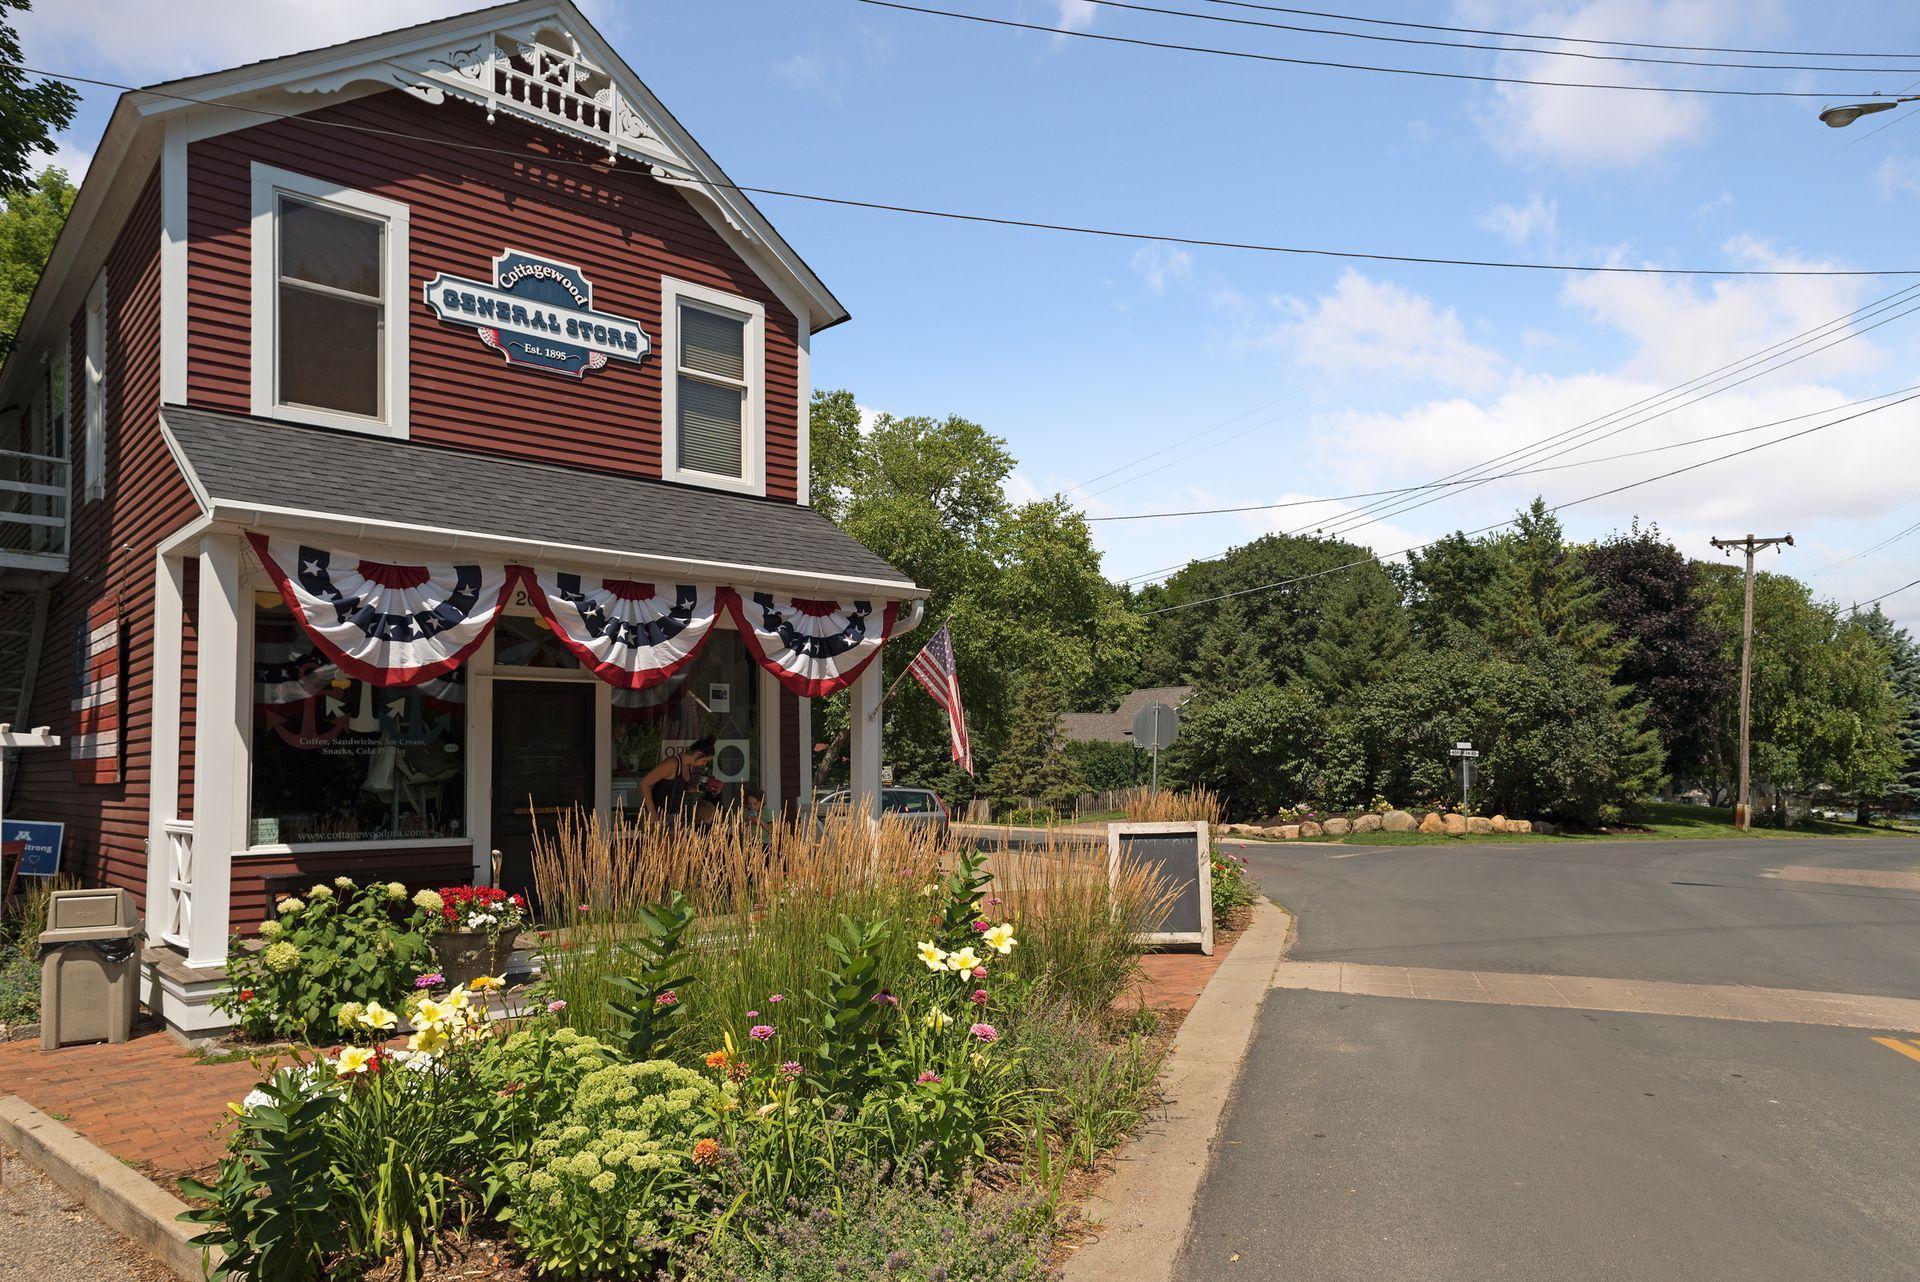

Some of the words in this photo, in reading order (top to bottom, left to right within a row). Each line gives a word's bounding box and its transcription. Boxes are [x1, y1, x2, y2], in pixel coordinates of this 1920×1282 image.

[499, 263, 588, 306] Cottagewood
[442, 289, 561, 334] GENERAL
[566, 318, 638, 351] STORE
[524, 343, 543, 356] Est.
[545, 348, 567, 361] 1895
[299, 738, 330, 747] Coffee,
[322, 747, 354, 756] Snacks,
[356, 747, 376, 756] Cold
